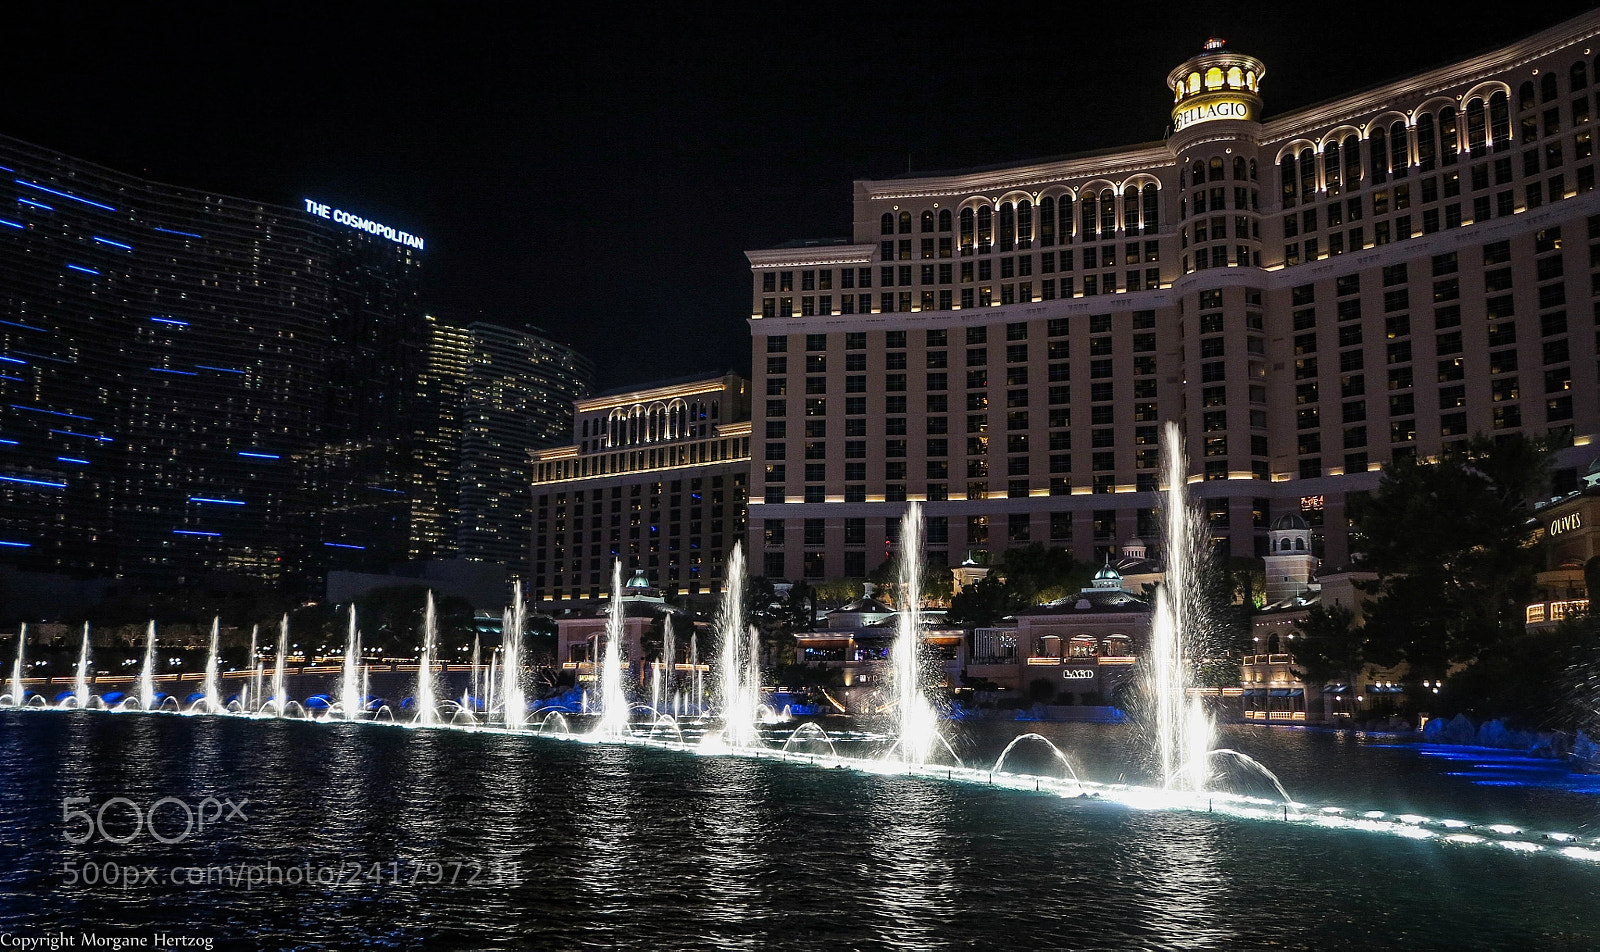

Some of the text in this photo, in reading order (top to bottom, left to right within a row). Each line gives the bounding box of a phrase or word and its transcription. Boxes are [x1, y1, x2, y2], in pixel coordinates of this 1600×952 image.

[1174, 102, 1247, 131] BELLAGIO
[304, 198, 424, 250] THE COSMOPOLITAN
